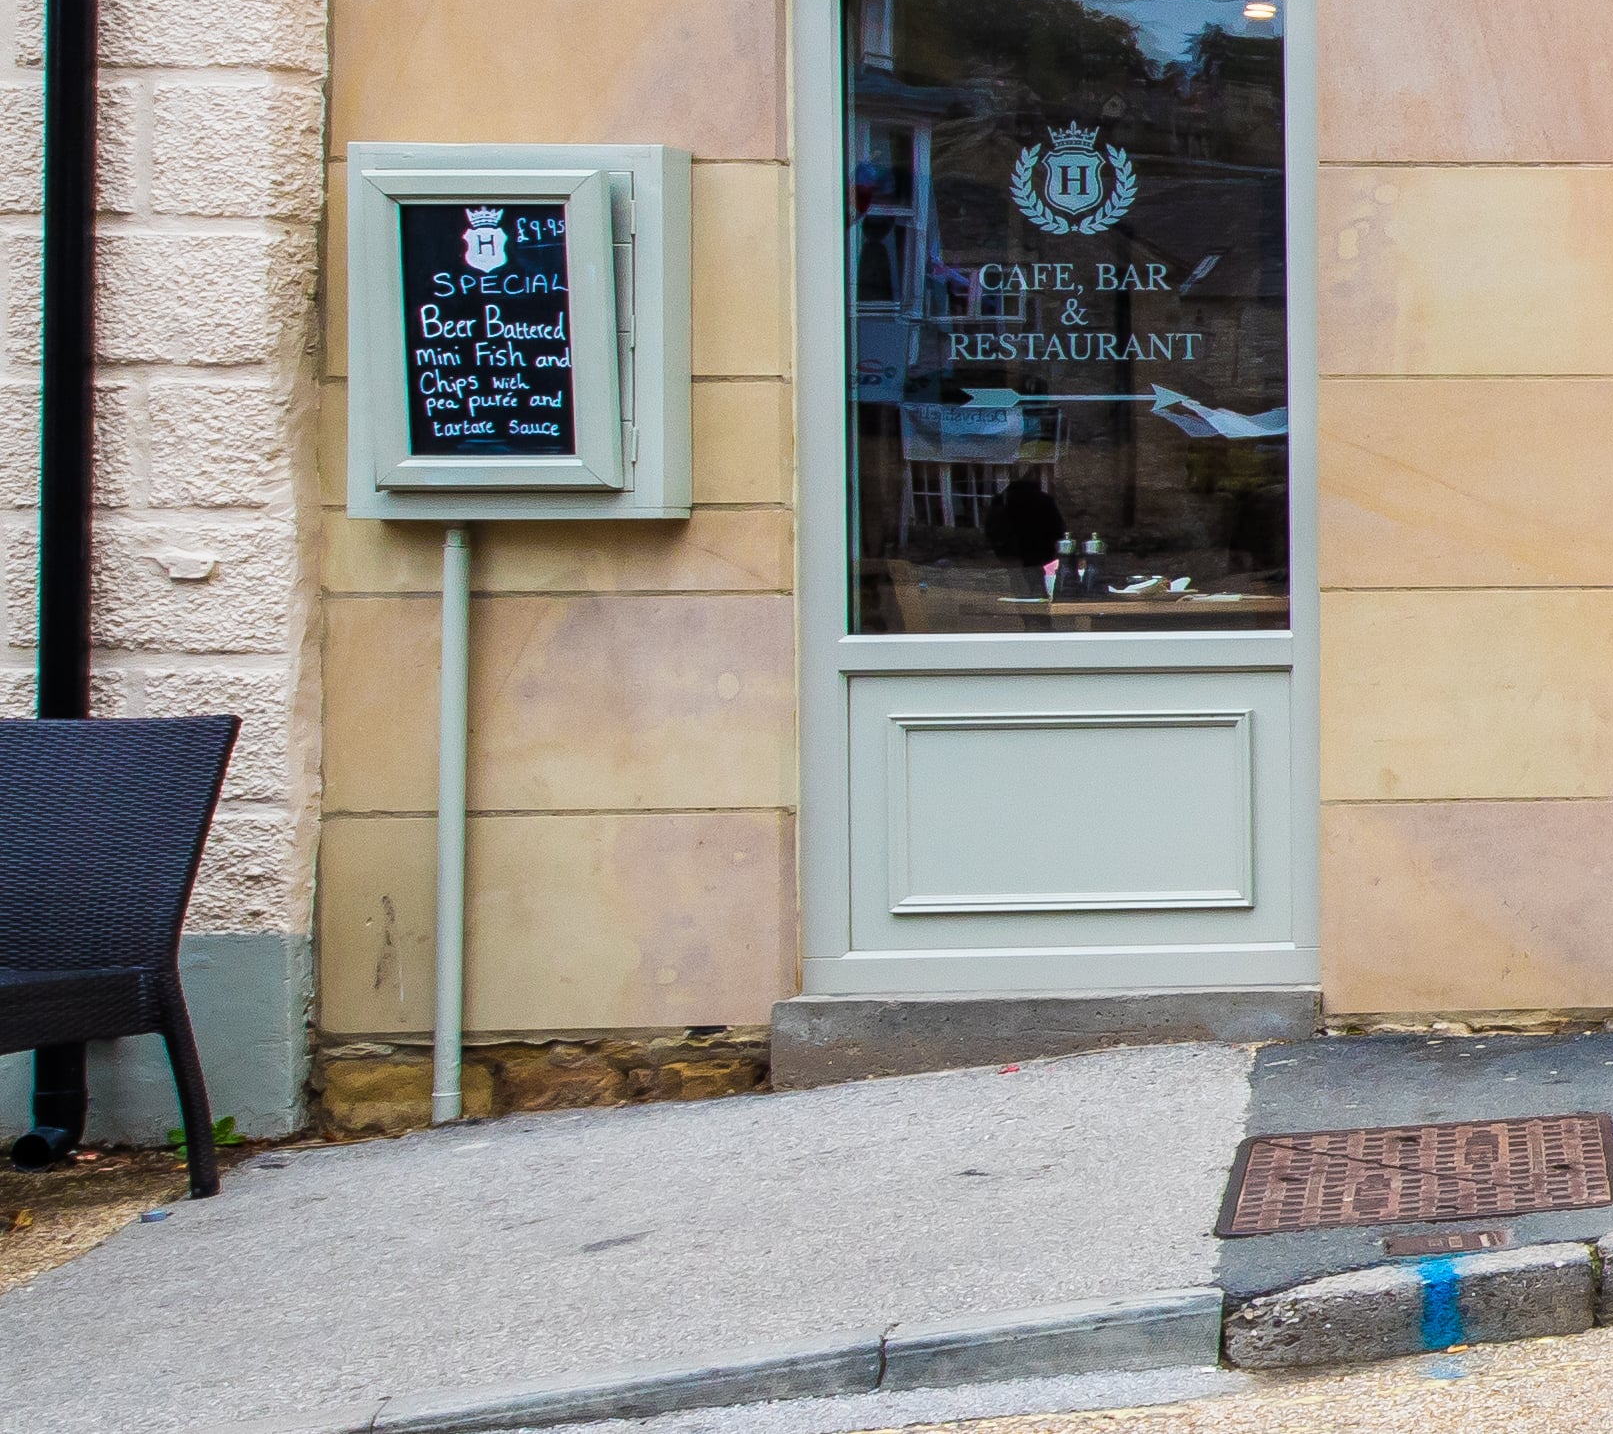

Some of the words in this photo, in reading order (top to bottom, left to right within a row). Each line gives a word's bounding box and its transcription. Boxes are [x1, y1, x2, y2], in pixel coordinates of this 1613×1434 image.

[1058, 165, 1089, 196] H
[477, 234, 495, 256] H
[433, 272, 569, 297] SPECIAL
[978, 263, 1083, 295] CAFE,
[1095, 263, 1172, 291] BAR
[420, 303, 477, 339] Beer
[485, 304, 566, 340] Battered
[1060, 297, 1089, 327] &
[415, 345, 462, 366] mini
[475, 341, 527, 366] Fish
[535, 347, 571, 368] and
[948, 333, 1203, 361] RESTAURANT
[420, 369, 479, 399] Chips
[425, 398, 460, 417] pea
[468, 392, 519, 417] purée
[529, 390, 562, 408] and
[433, 420, 495, 436] tartare
